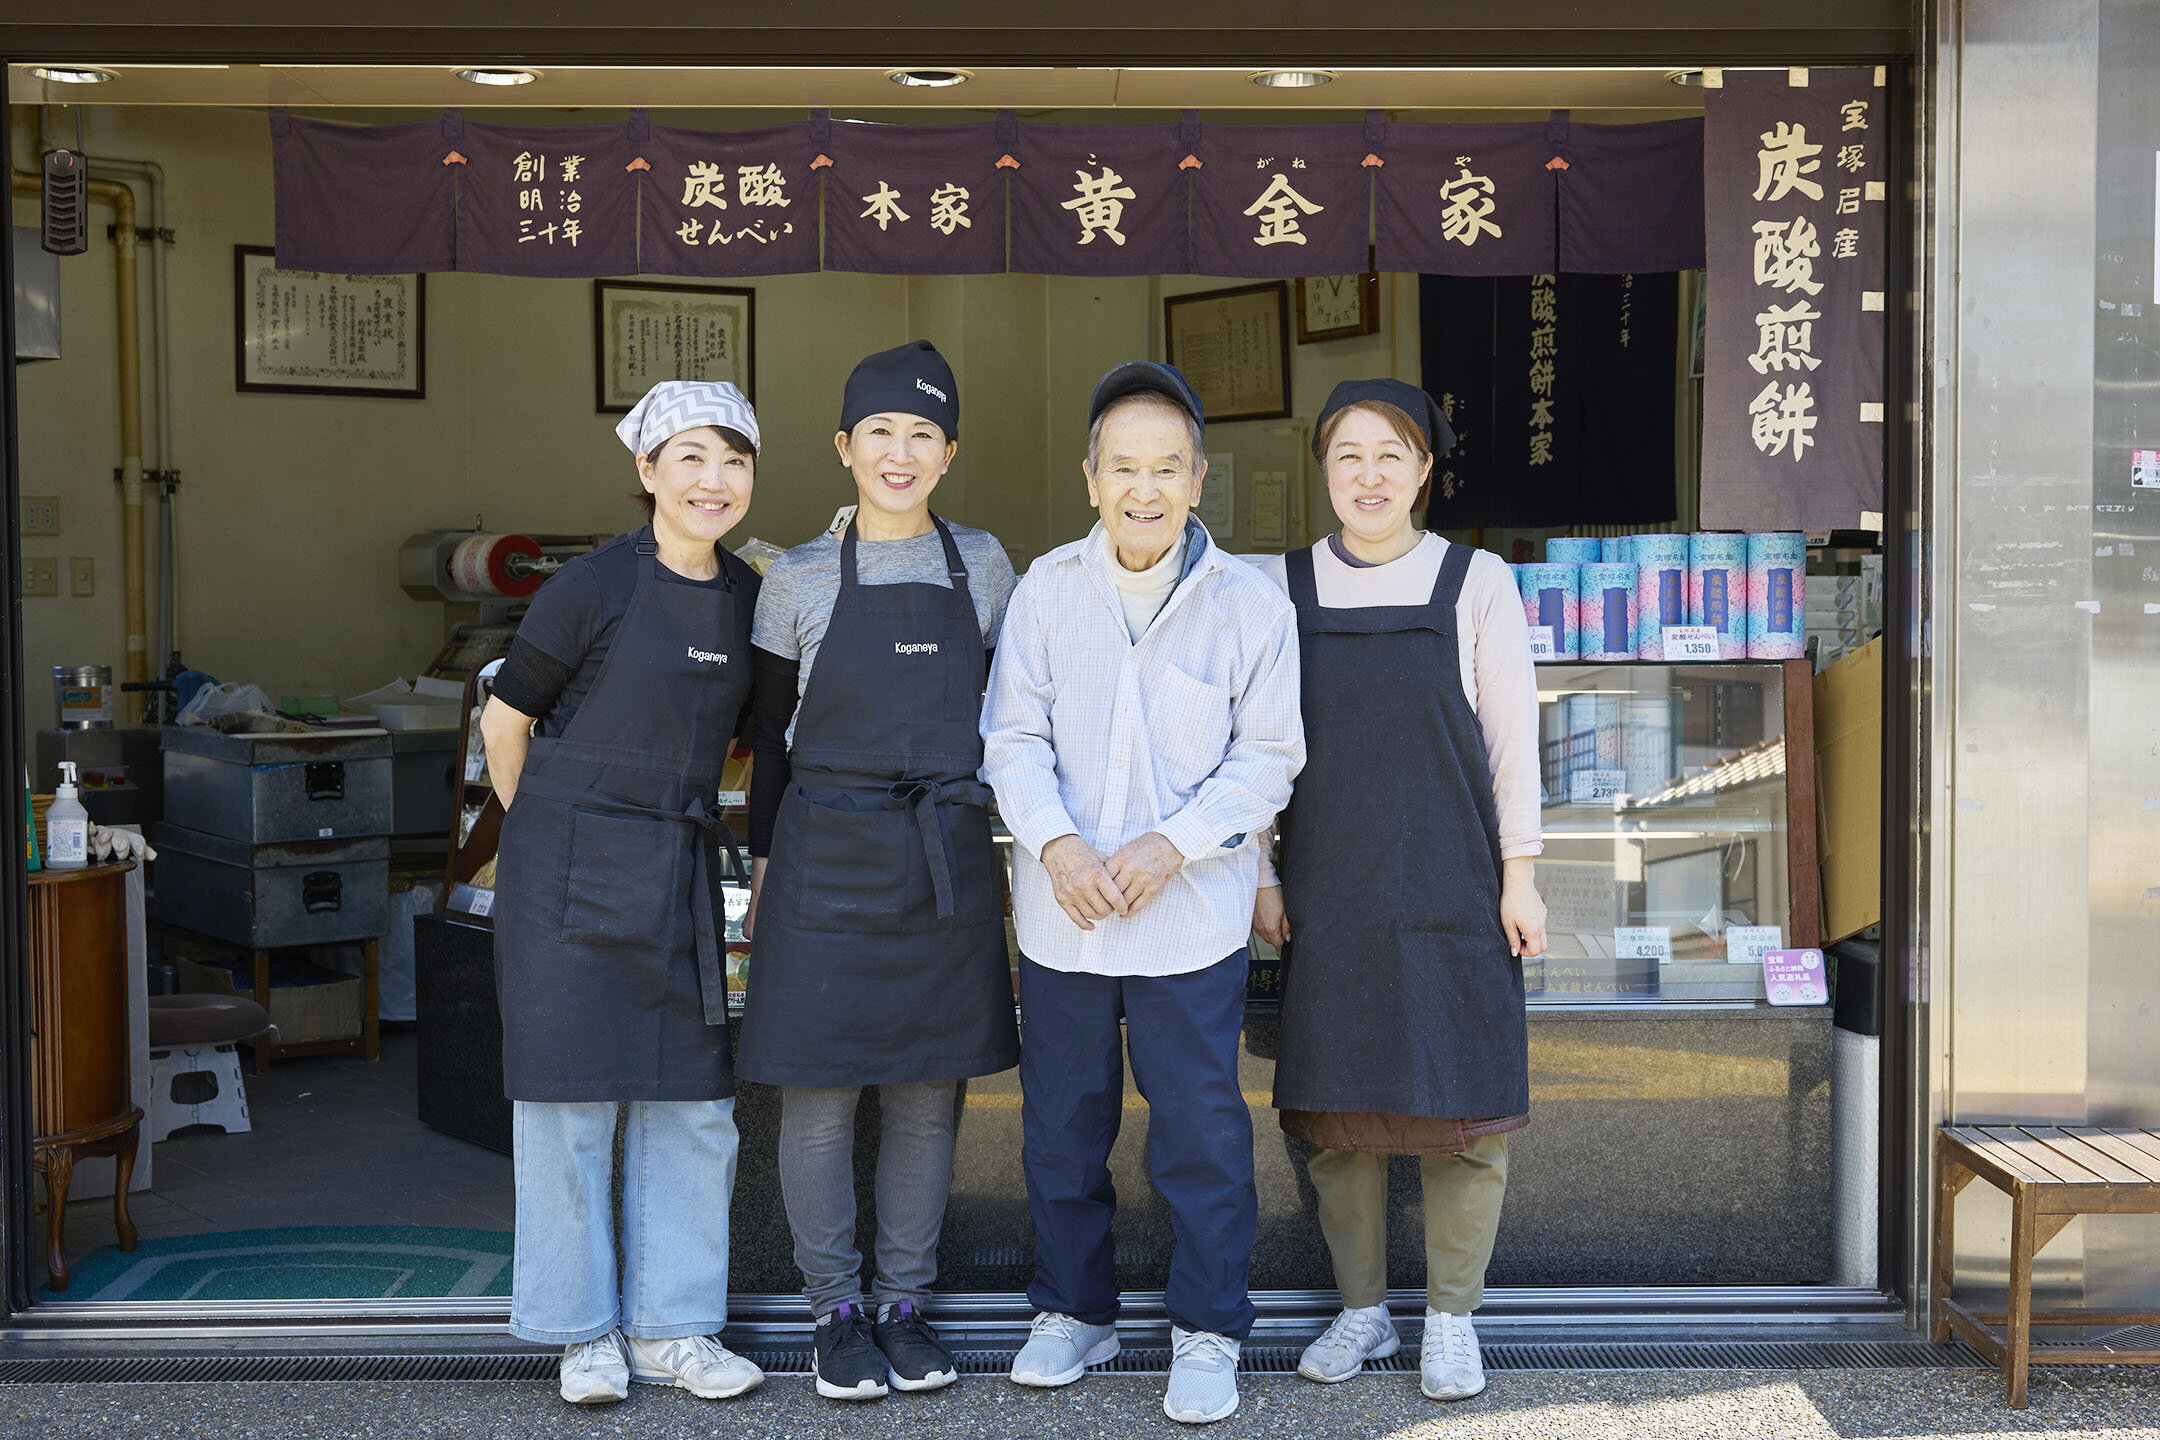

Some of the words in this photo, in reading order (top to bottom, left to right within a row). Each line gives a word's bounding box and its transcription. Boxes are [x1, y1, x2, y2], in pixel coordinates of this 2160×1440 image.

[513, 151, 586, 183] 創業
[1831, 99, 1869, 260] 宝塚名産
[681, 160, 792, 210] 炭酸
[519, 188, 582, 213] 明治
[859, 180, 971, 235] 本家
[517, 217, 583, 248] 三十年
[675, 217, 793, 246] せんべい
[1747, 121, 1825, 463] 炭酸煎餅
[916, 377, 947, 403] Koganeya
[895, 641, 939, 656] Koganeya
[1671, 633, 1716, 641] 炭酸せんべい
[687, 646, 728, 666] Koganeya
[1767, 955, 1784, 965] 宝塚
[1768, 965, 1804, 973] ふるさと納税
[1770, 973, 1811, 982] 人気返礼品
